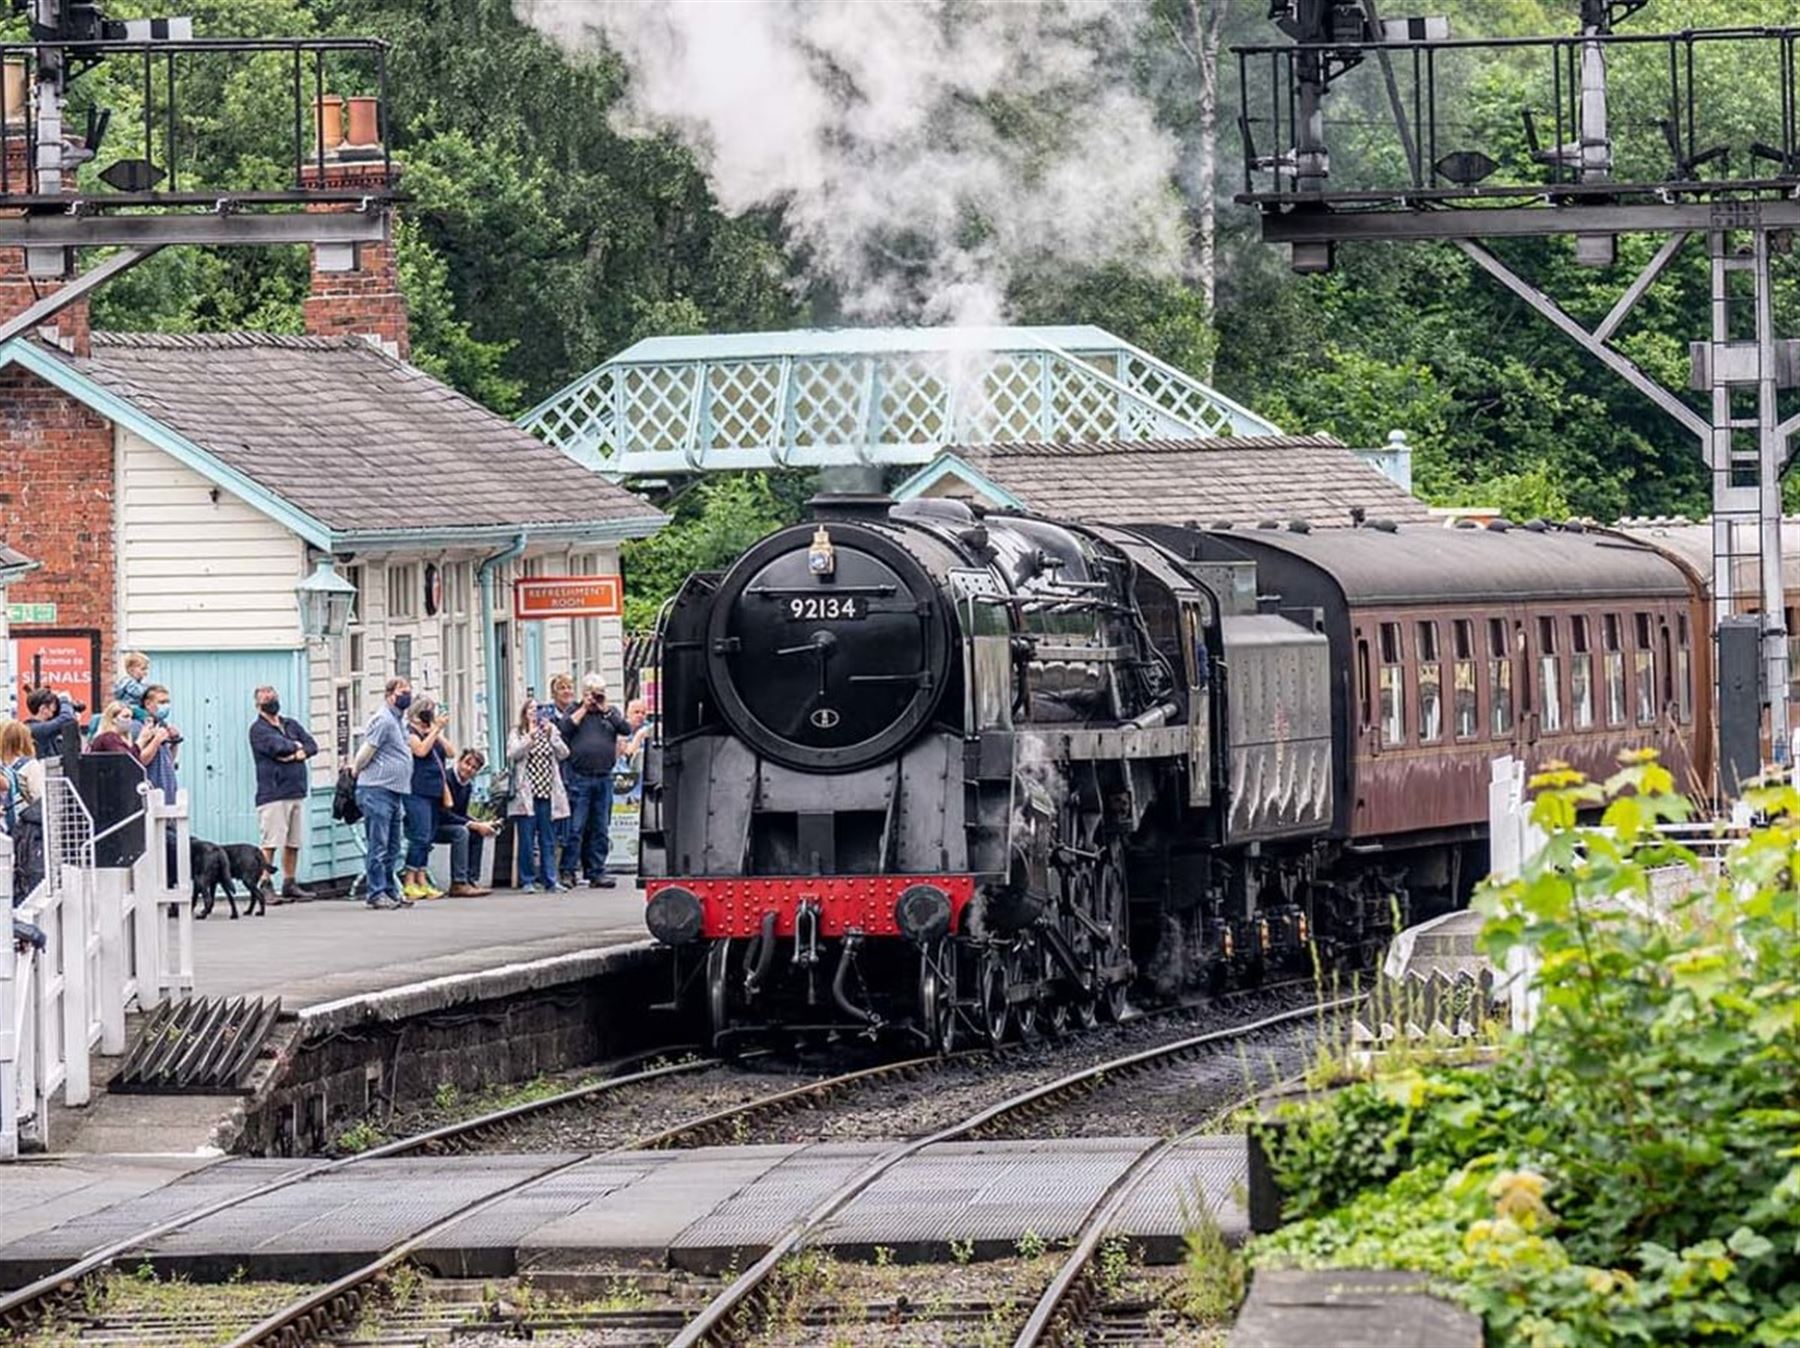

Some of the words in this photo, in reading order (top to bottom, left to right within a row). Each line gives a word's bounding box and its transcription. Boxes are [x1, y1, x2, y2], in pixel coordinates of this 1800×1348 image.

[528, 587, 605, 598] REFRESHMENT
[551, 597, 585, 607] ROOM
[790, 598, 856, 618] 92134
[38, 646, 46, 654] A
[48, 647, 76, 655] warm
[30, 657, 71, 665] wlcome
[22, 671, 92, 683] SIGNALS
